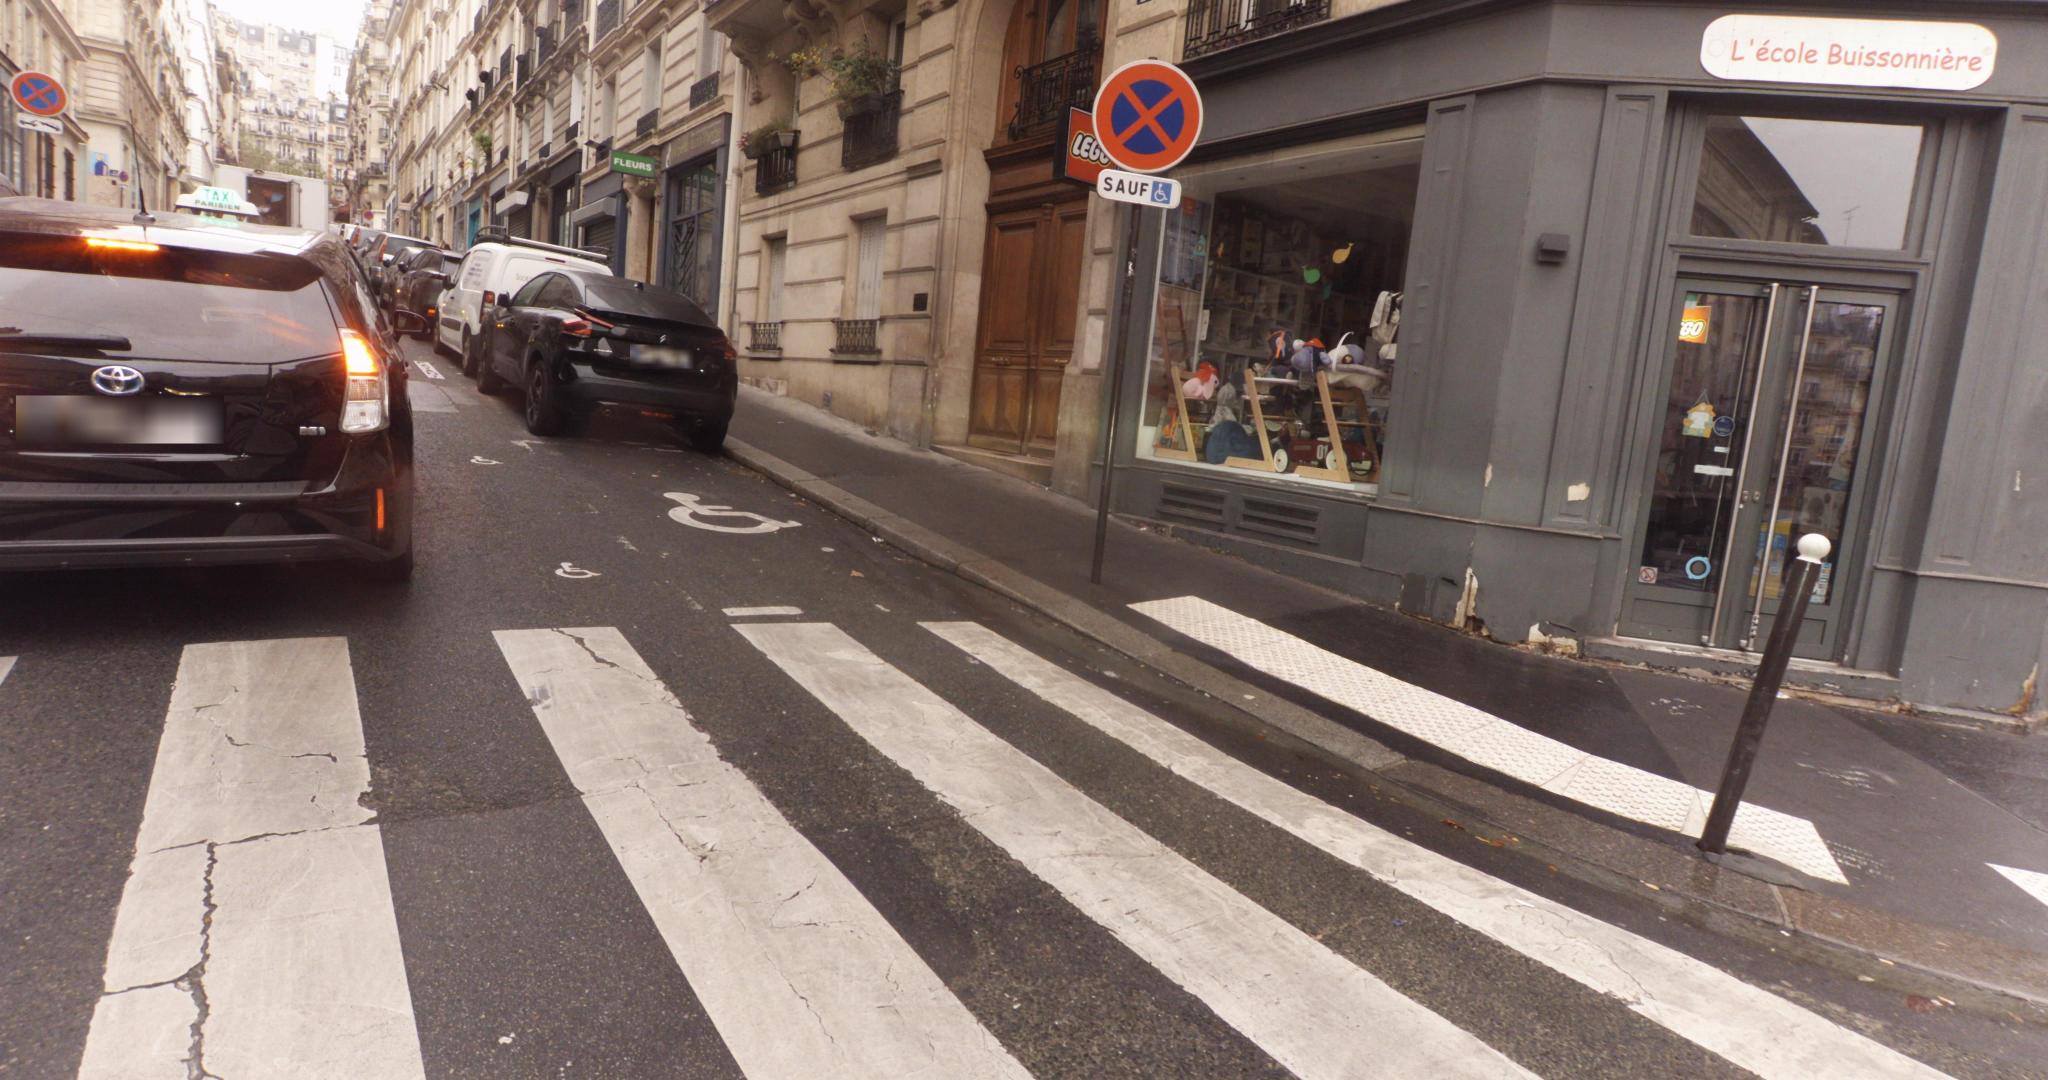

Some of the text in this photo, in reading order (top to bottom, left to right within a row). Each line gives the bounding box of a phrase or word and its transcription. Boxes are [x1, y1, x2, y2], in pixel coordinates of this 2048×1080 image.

[1731, 39, 1983, 72] L'école Buissonnière
[614, 157, 652, 171] FLEURS
[1104, 177, 1149, 196] SAUF
